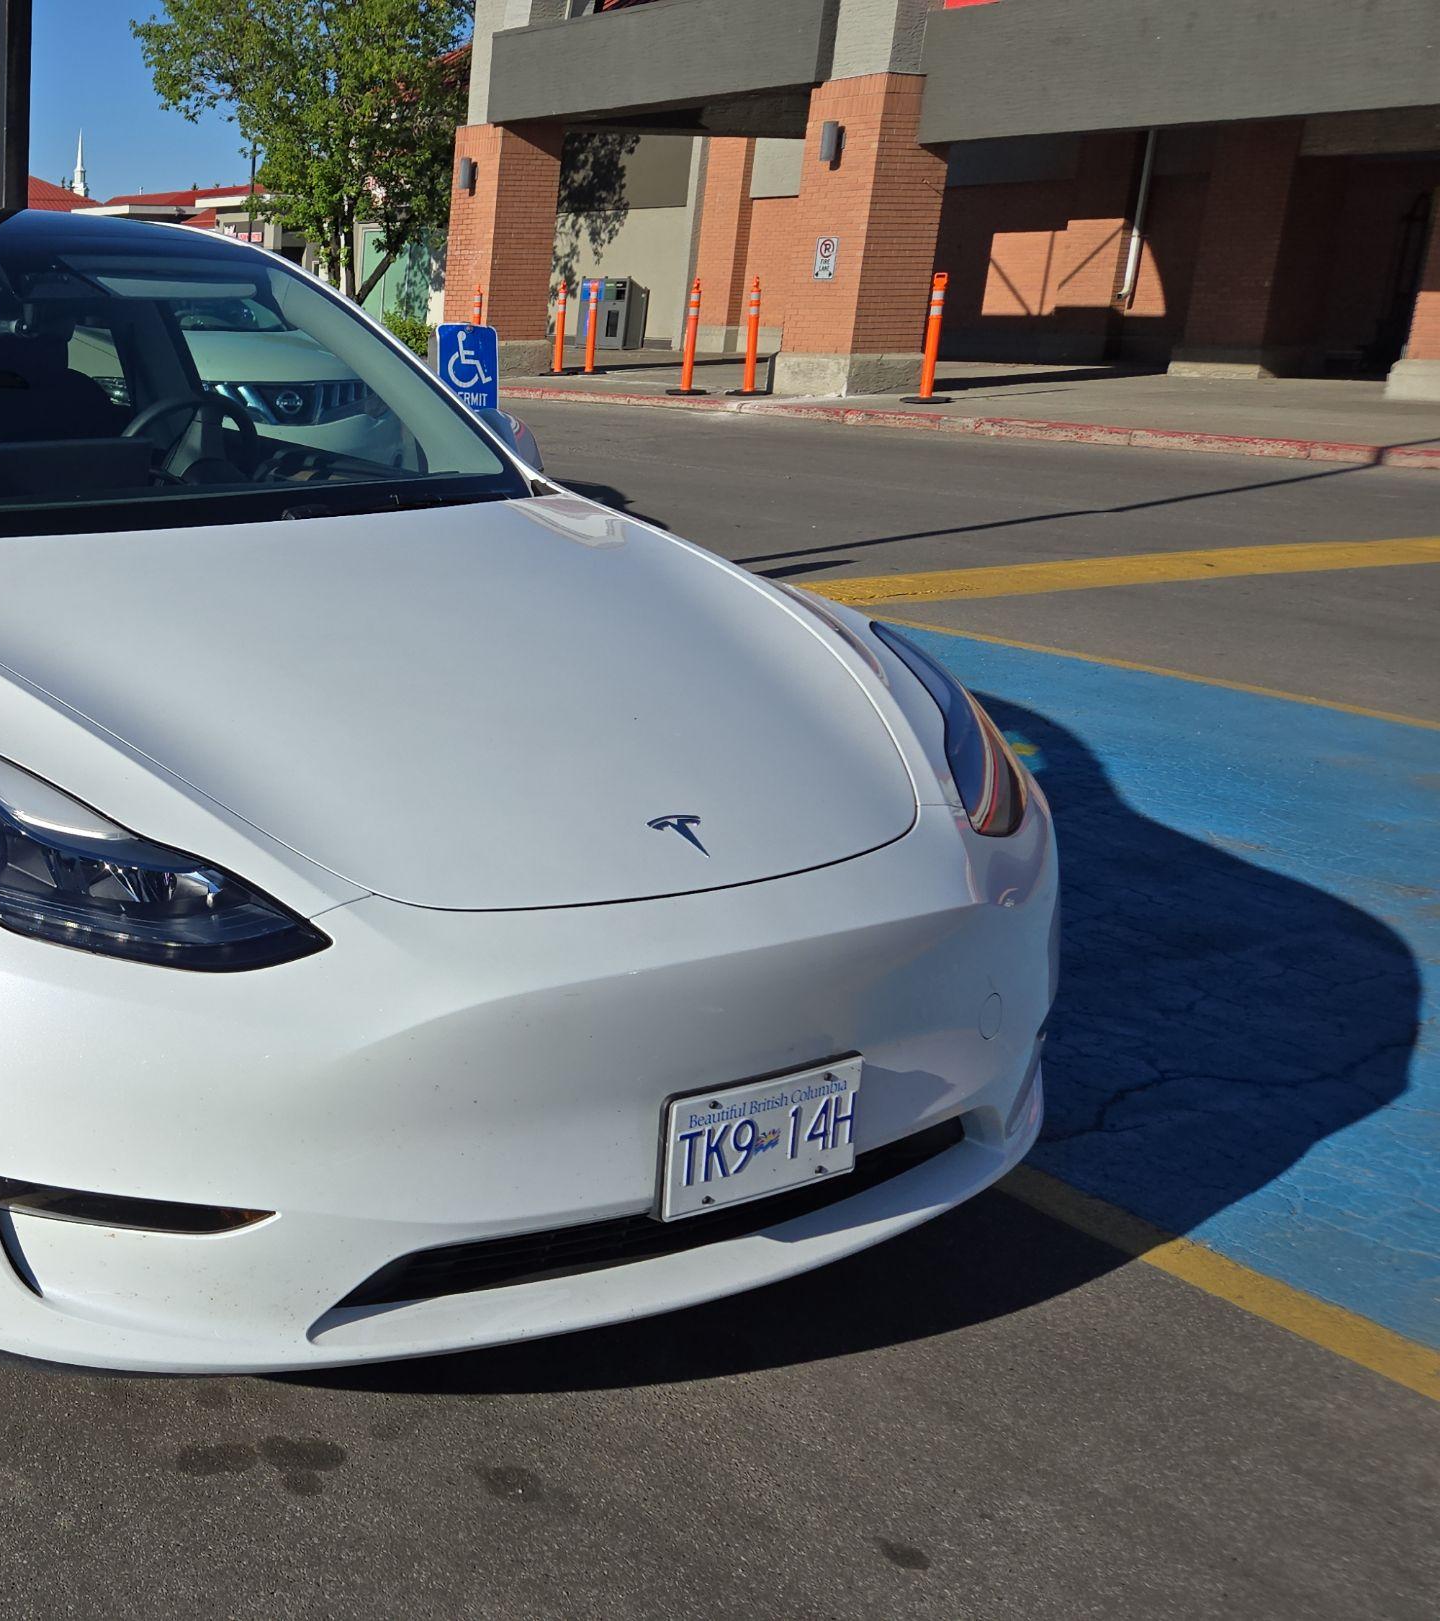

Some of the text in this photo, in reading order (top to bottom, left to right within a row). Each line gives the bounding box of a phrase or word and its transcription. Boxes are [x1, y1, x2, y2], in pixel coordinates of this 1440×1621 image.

[457, 391, 488, 407] ERMIT
[689, 1079, 848, 1129] Beautiful British Columbia
[677, 1091, 857, 1187] TK9 14H
